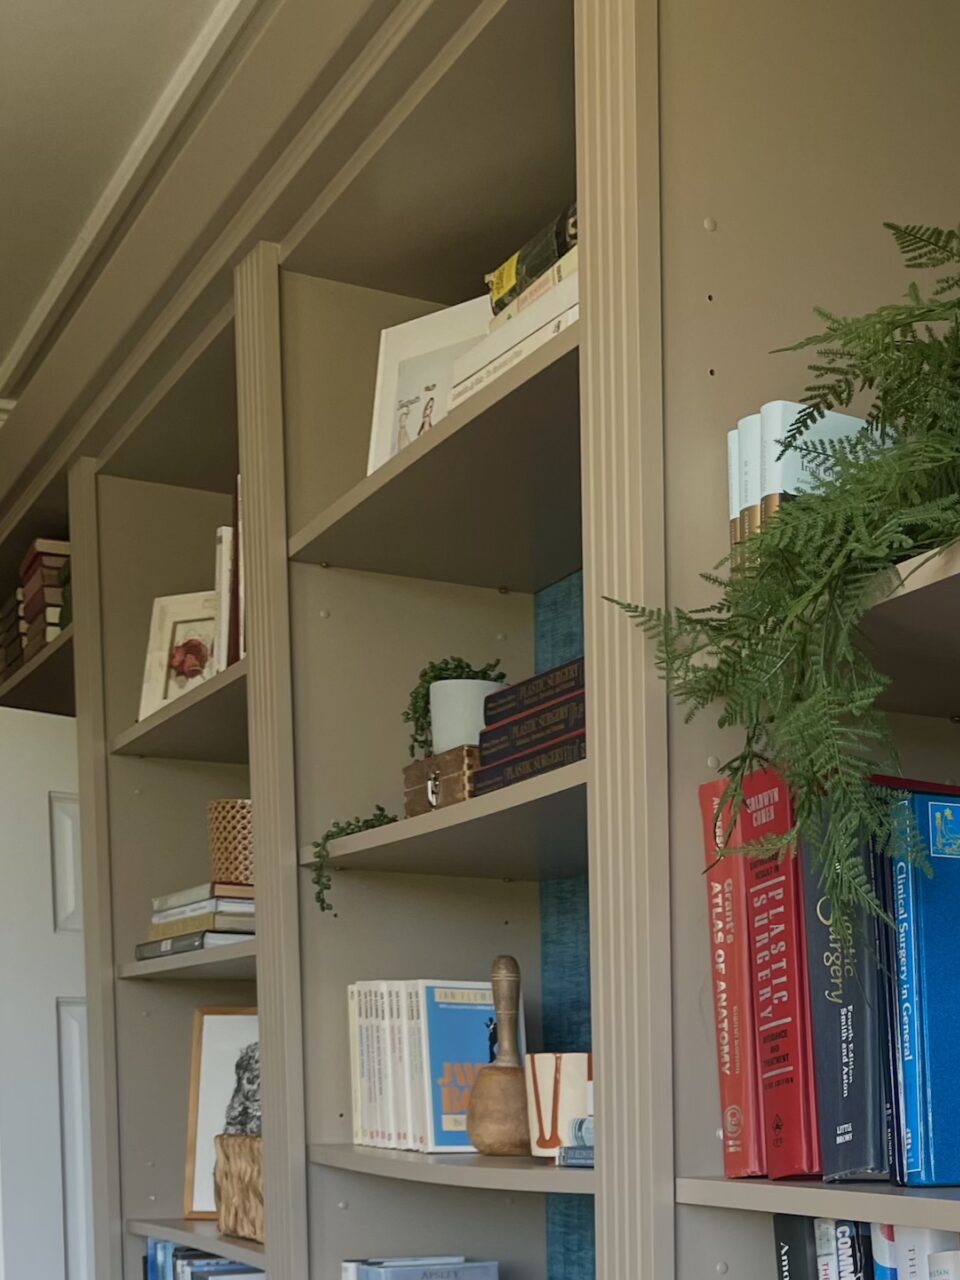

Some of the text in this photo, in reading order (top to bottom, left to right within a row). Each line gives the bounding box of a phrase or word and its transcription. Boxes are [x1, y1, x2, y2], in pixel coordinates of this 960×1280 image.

[710, 882, 730, 1075] ATLAS OF ANATOMY
[753, 894, 774, 1019] SURGERY
[767, 887, 789, 1004] PLASTIC
[896, 861, 914, 1062] Clinical Surgery in General
[907, 1245, 918, 1278] THE
